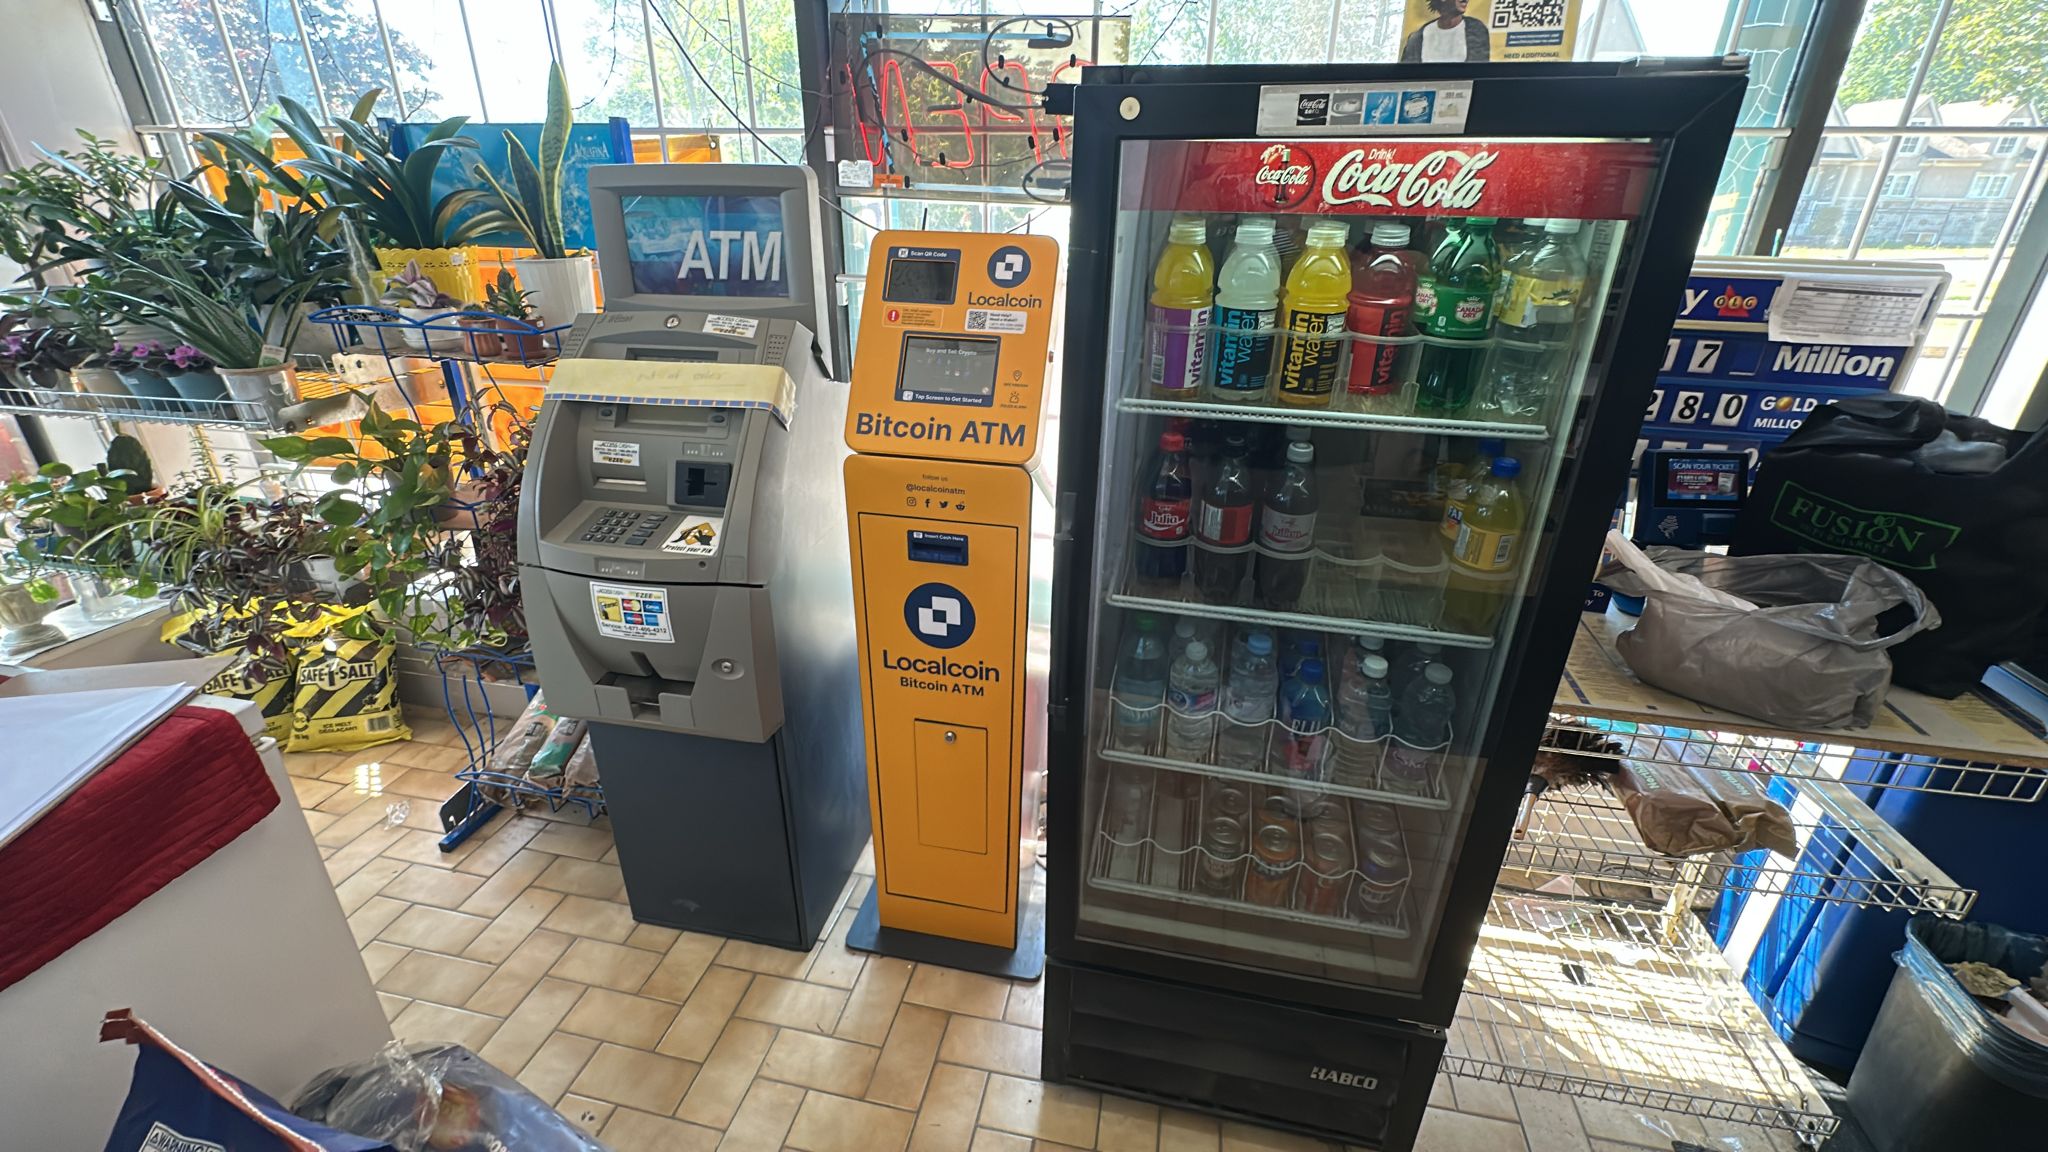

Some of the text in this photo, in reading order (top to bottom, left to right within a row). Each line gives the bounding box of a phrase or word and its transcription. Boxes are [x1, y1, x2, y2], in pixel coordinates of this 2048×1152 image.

[1256, 164, 1312, 186] Coca-Cola
[1322, 149, 1500, 209] Coca-Cola
[677, 230, 782, 282] ATM
[968, 291, 1043, 309] Localcoin
[1220, 309, 1241, 386] vitamin
[1237, 312, 1256, 364] water
[1285, 312, 1310, 390] vitamin
[1303, 313, 1326, 368] water
[1772, 345, 1896, 378] Million
[856, 412, 1026, 447] Bitcoin ATM
[1753, 417, 1803, 430] MILLIO
[906, 483, 966, 495] @localcoinatm
[1788, 498, 1926, 552] FUSION
[882, 649, 1000, 683] Localcoin
[900, 677, 985, 697] Bitcoin ATM
[1310, 1066, 1379, 1090] HABCO
